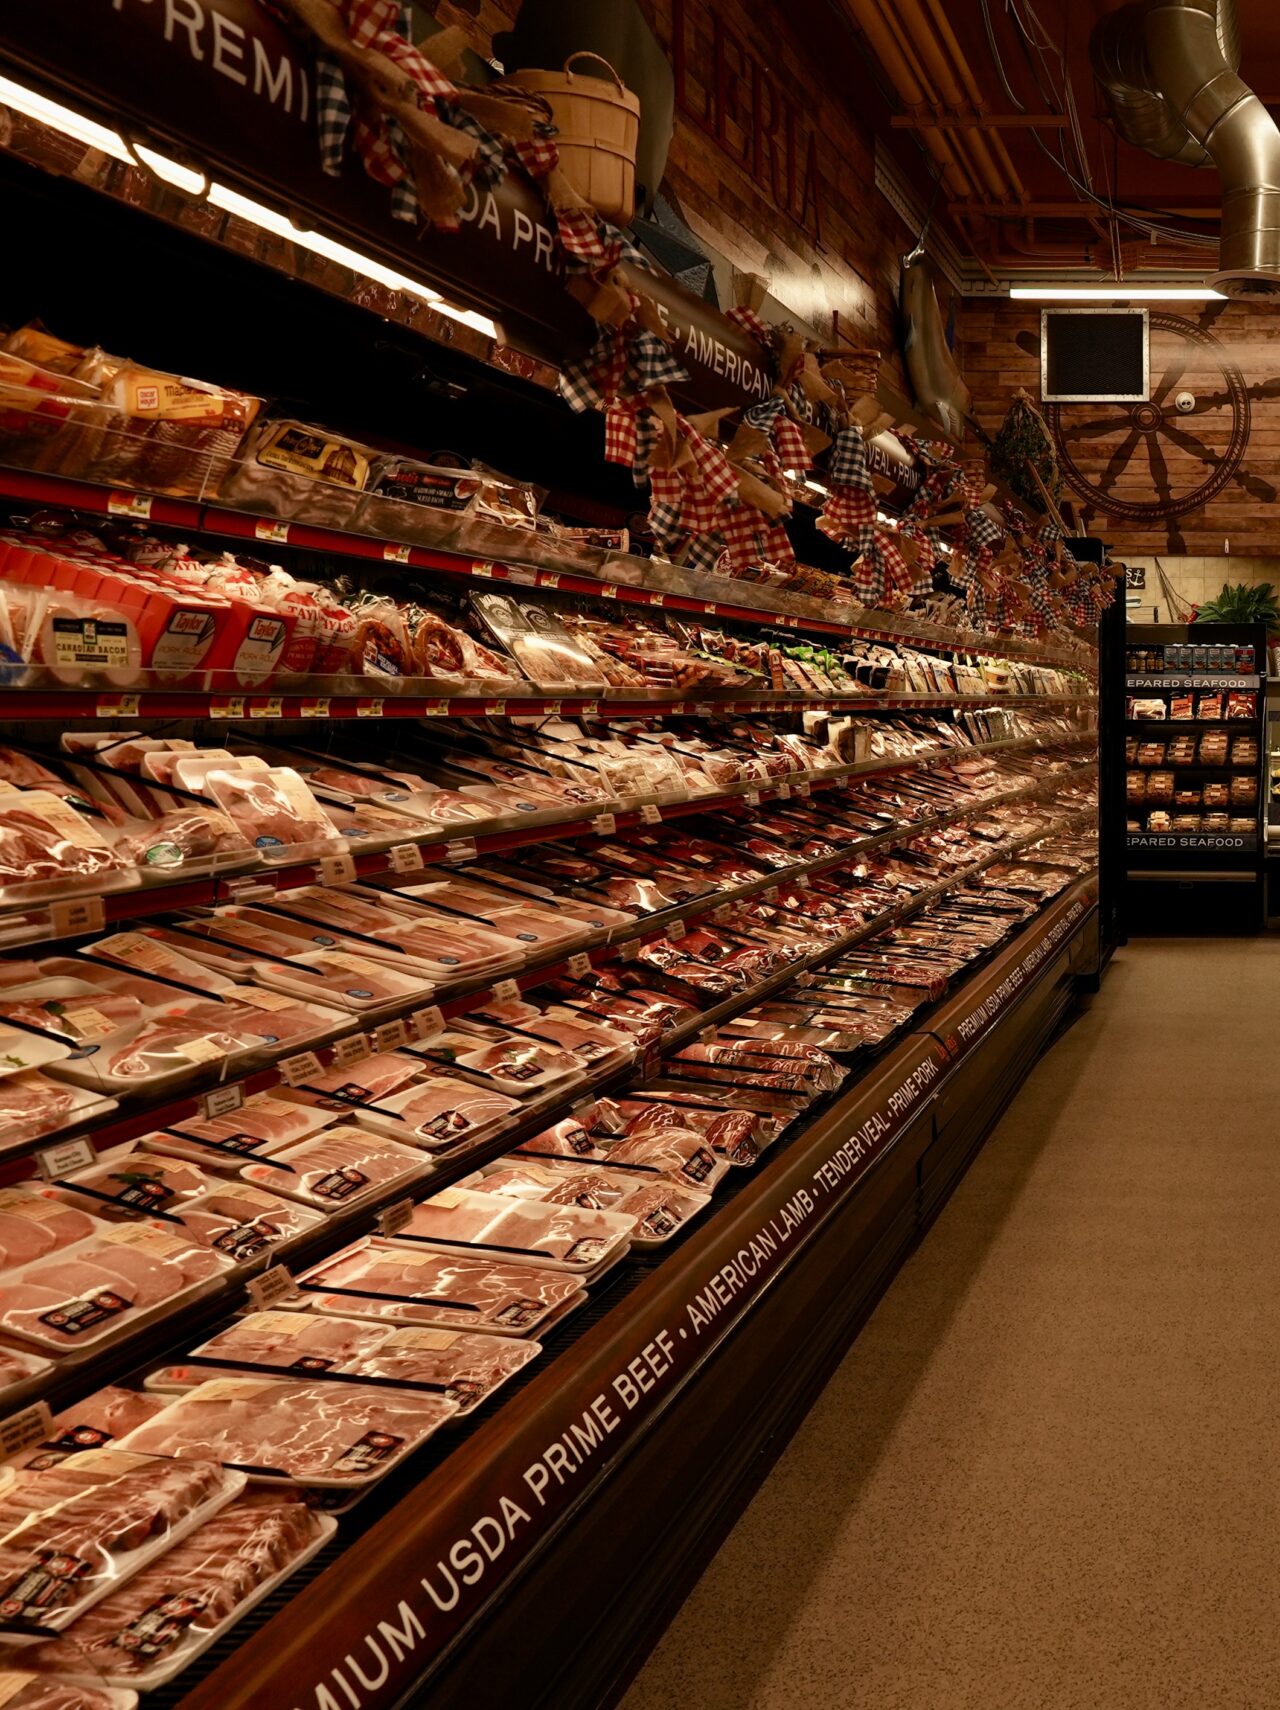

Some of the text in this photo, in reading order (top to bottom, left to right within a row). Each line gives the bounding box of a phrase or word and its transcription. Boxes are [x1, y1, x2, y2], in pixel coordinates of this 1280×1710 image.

[112, 0, 310, 122] REMI
[513, 208, 562, 277] PR
[684, 325, 773, 400] AMERICAN
[868, 441, 891, 477] VEAL
[175, 612, 204, 632] Taylor
[256, 619, 278, 638] Taylor
[56, 643, 126, 654] CANADIAN BACON
[1127, 680, 1247, 688] EPARED SEAFOOD
[1179, 838, 1244, 847] SEAFOOD
[421, 1495, 532, 1613] USDA
[522, 1393, 621, 1507] PRIME
[612, 1329, 679, 1411] BEEF
[686, 1228, 779, 1335] AMERICAN
[770, 1188, 815, 1243] LAMB
[813, 1136, 866, 1193] TENDER
[857, 1111, 891, 1148] VEAL
[888, 1078, 919, 1118] PRIME
[912, 1056, 939, 1090] PORK
